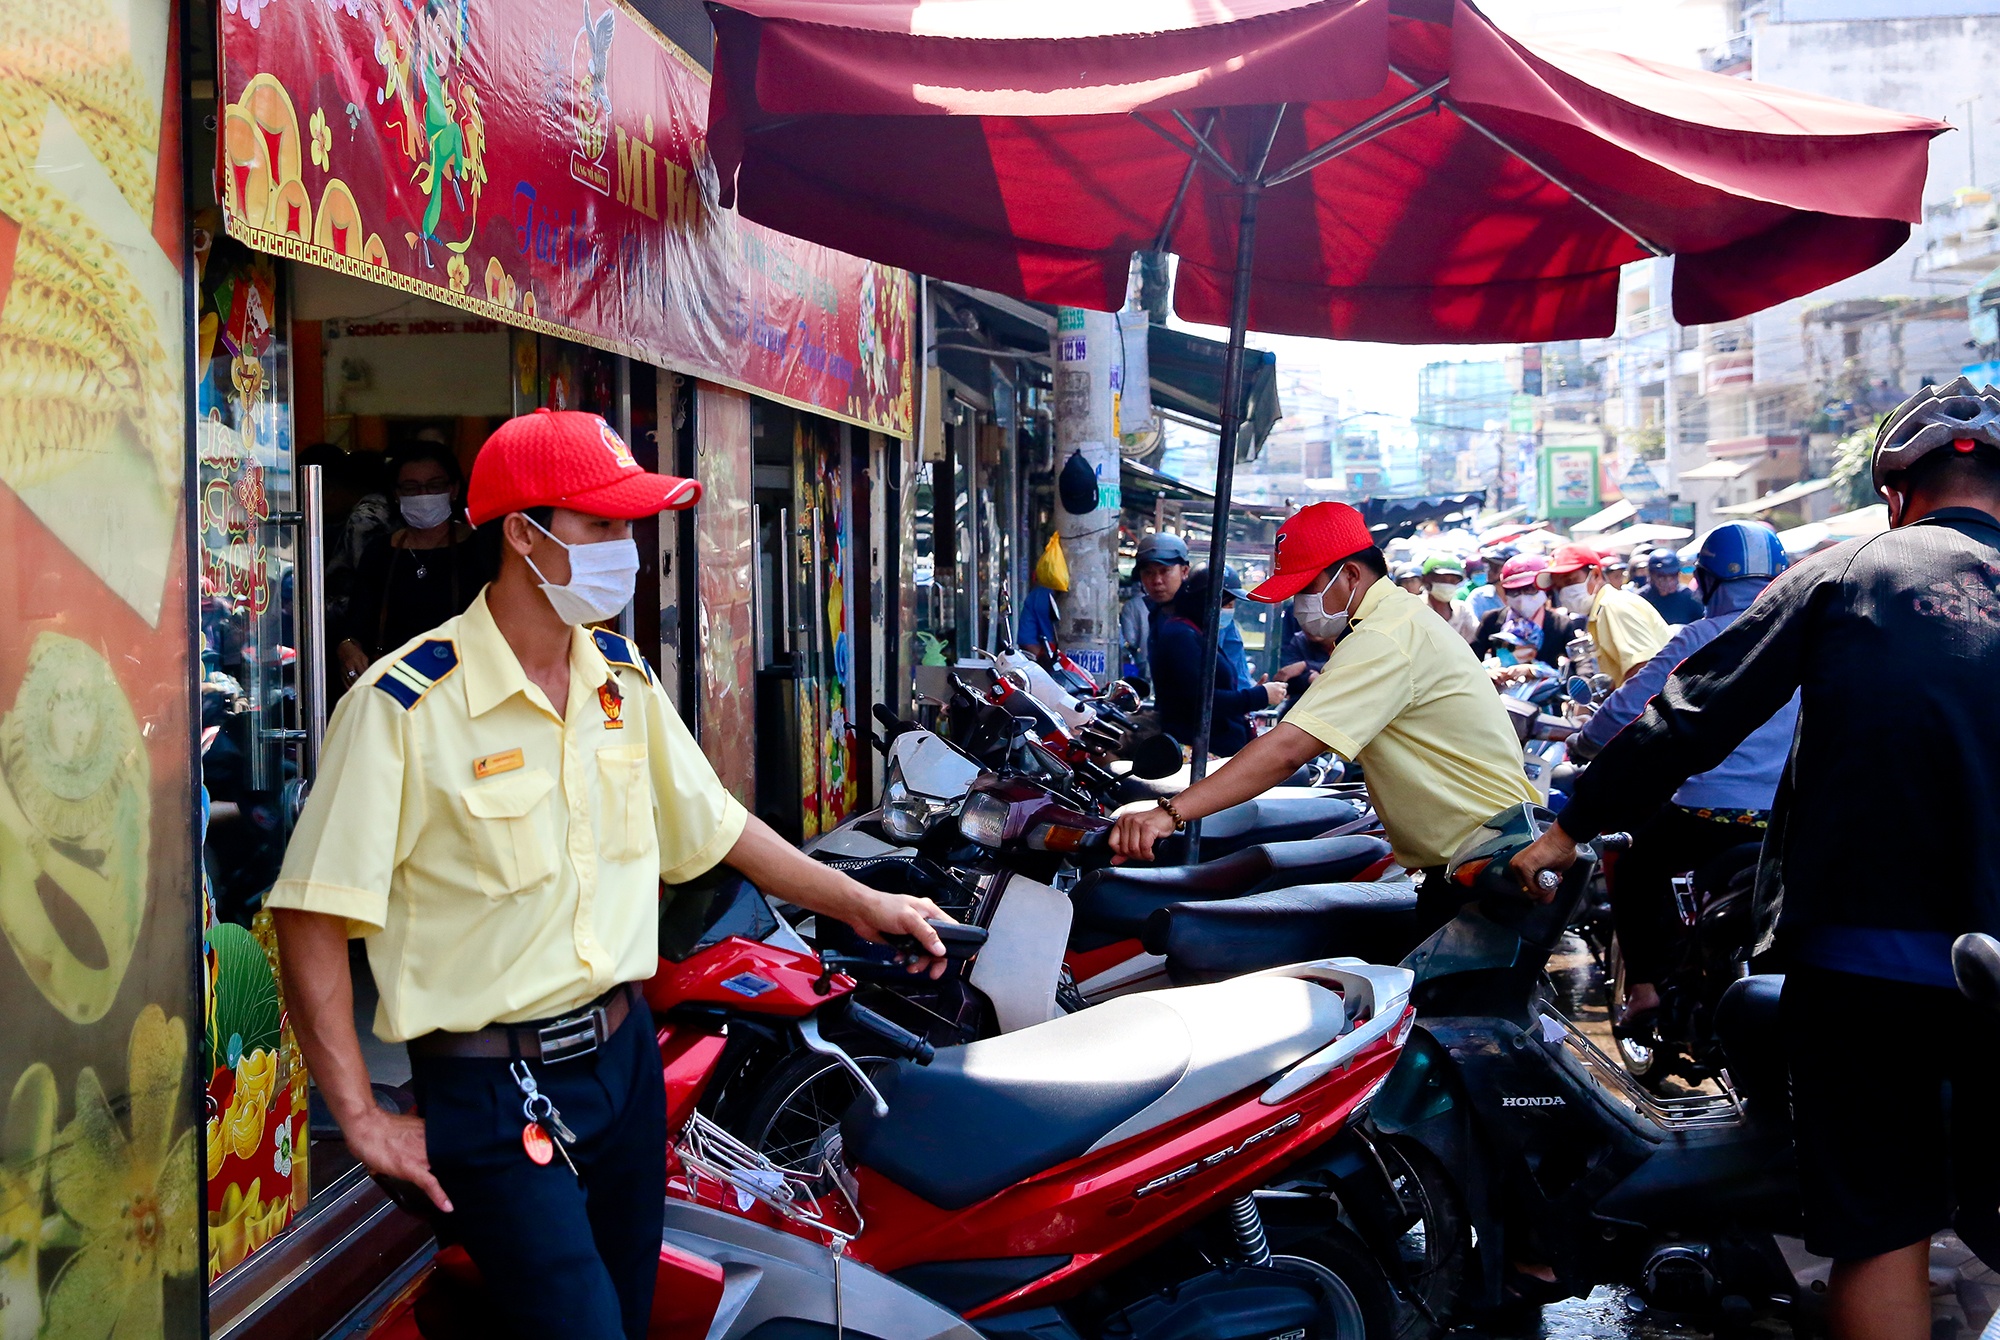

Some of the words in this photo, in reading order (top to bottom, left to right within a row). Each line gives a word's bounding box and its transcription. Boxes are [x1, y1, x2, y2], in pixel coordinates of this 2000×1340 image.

[512, 181, 558, 266] Tài
[200, 536, 230, 597] hú
[1502, 1096, 1566, 1107] HONDA
[1136, 1162, 1198, 1196] AIR
[1203, 1112, 1301, 1165] BLADE
